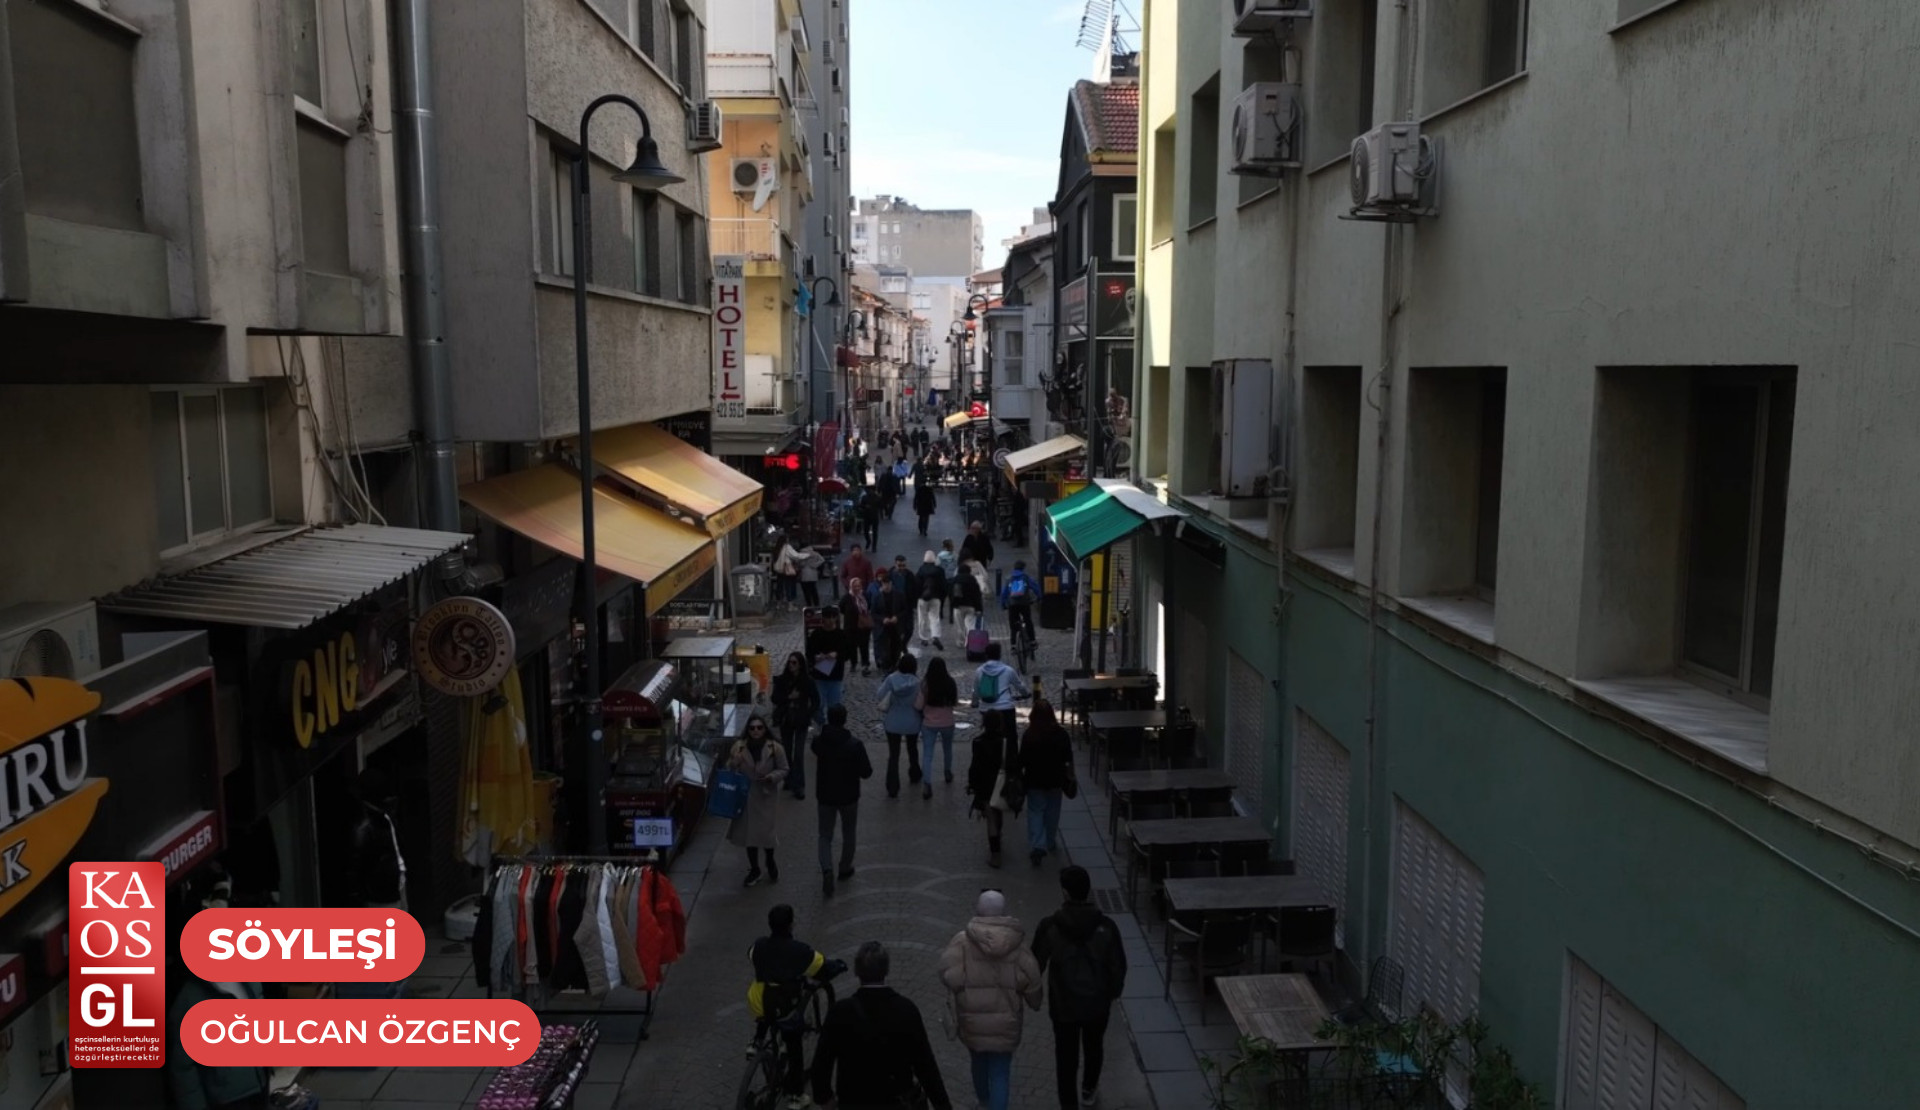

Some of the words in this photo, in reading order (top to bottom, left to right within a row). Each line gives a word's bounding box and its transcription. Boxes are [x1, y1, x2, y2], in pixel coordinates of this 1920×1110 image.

[716, 284, 742, 390] HOTEL
[292, 629, 359, 750] CNG
[438, 676, 486, 692] Studio
